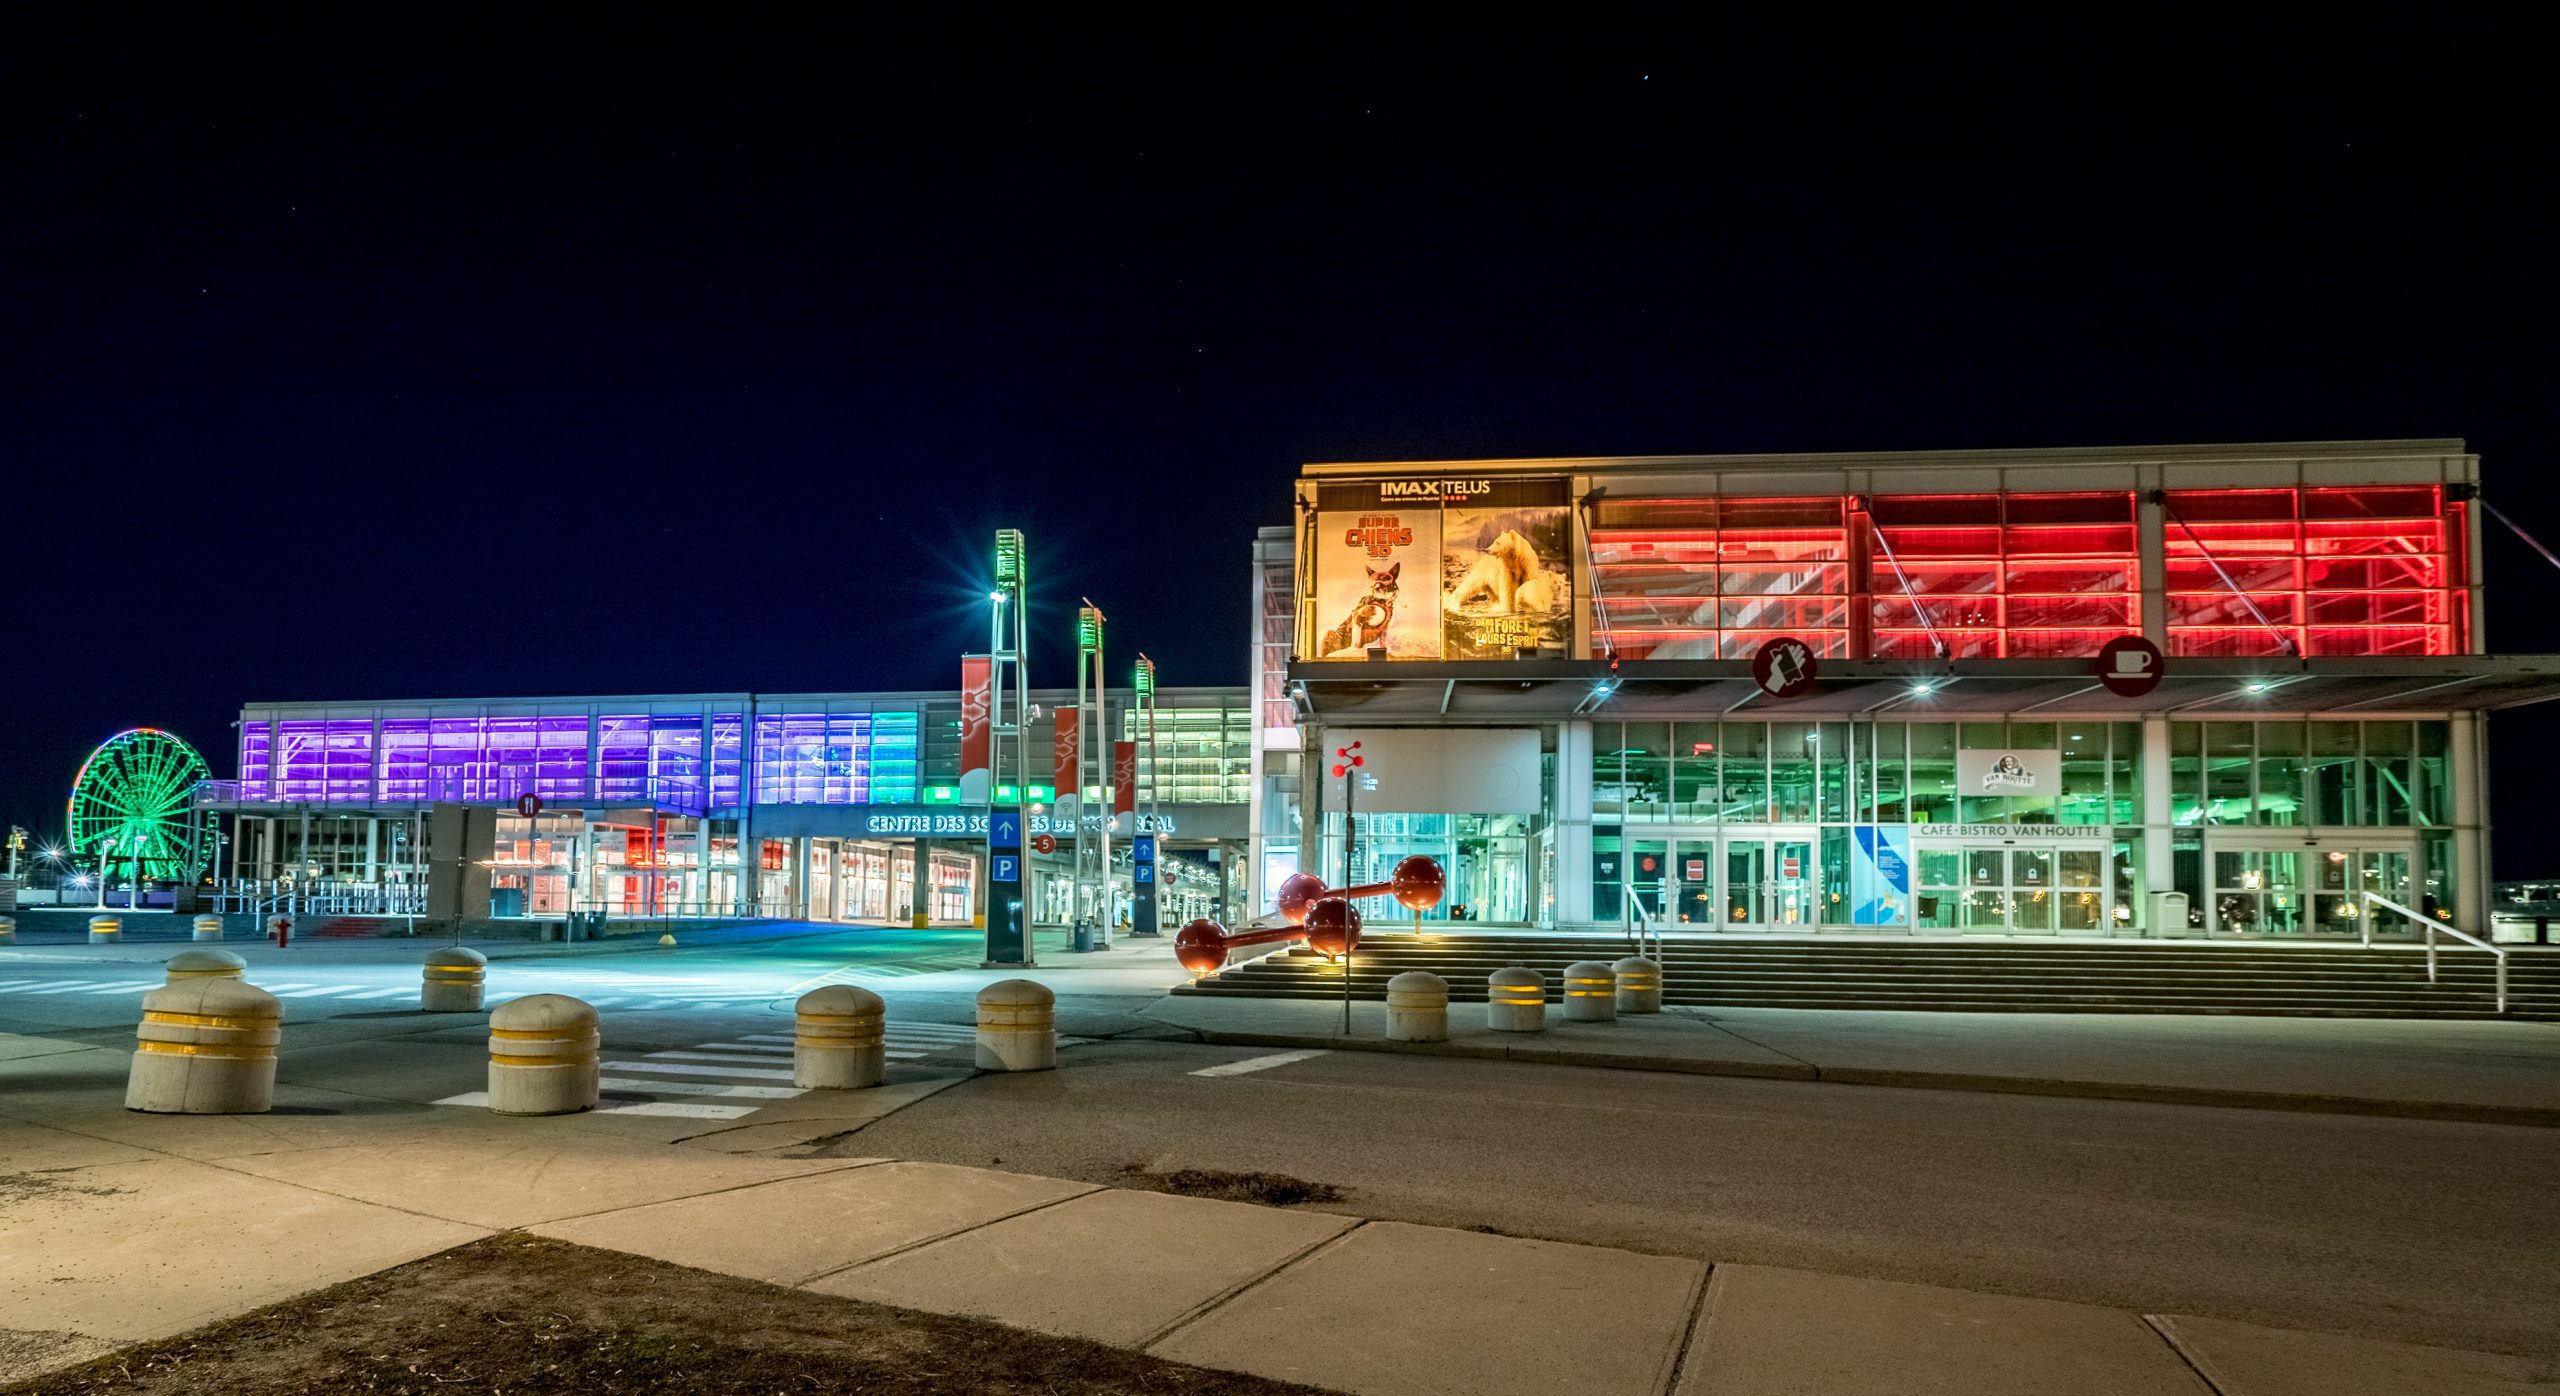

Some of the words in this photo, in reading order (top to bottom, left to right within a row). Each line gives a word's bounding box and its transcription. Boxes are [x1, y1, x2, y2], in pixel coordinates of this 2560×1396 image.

[1381, 482, 1439, 495] IMAX
[1444, 481, 1490, 494] TELUS
[1358, 517, 1400, 528] SUPER
[1345, 528, 1413, 547] CHIENS
[1367, 545, 1392, 557] 3D
[1986, 774, 2000, 782] VAN
[2003, 774, 2032, 784] HOUTTE
[867, 815, 930, 832] CENTRE
[934, 815, 966, 832] DES
[1052, 816, 1076, 832] DE
[1921, 824, 2007, 836] CAFÉ-BISTRO
[2013, 826, 2041, 836] VAN
[2045, 826, 2101, 837] HOUTTE
[1042, 839, 1049, 849] 5
[1000, 860, 1012, 877] P
[1140, 868, 1149, 879] P
